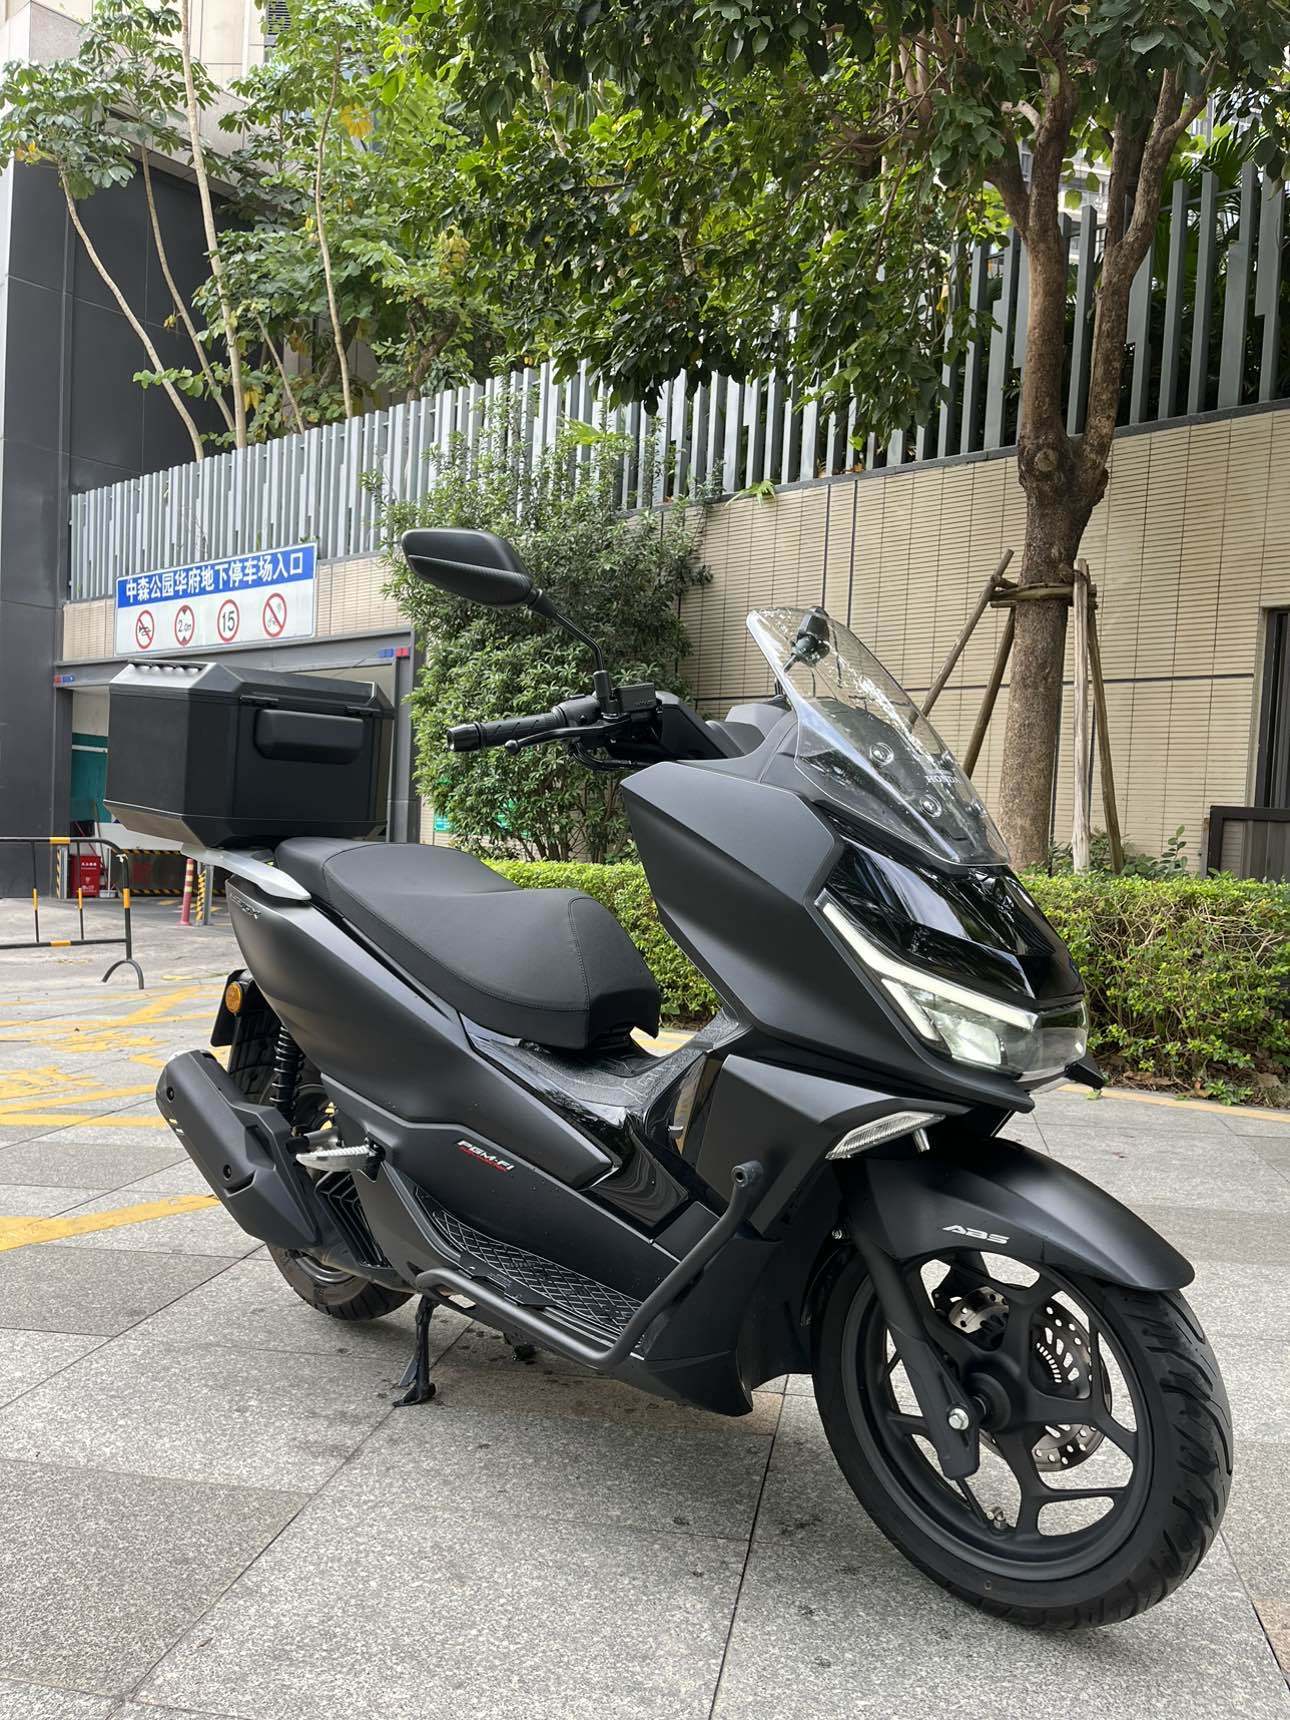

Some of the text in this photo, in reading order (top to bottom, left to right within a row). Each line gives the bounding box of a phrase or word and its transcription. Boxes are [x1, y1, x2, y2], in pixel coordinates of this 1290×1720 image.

[126, 551, 304, 603] 中森公园华府地下停车场入口
[222, 610, 235, 632] 15
[942, 1225, 1010, 1244] ABS
